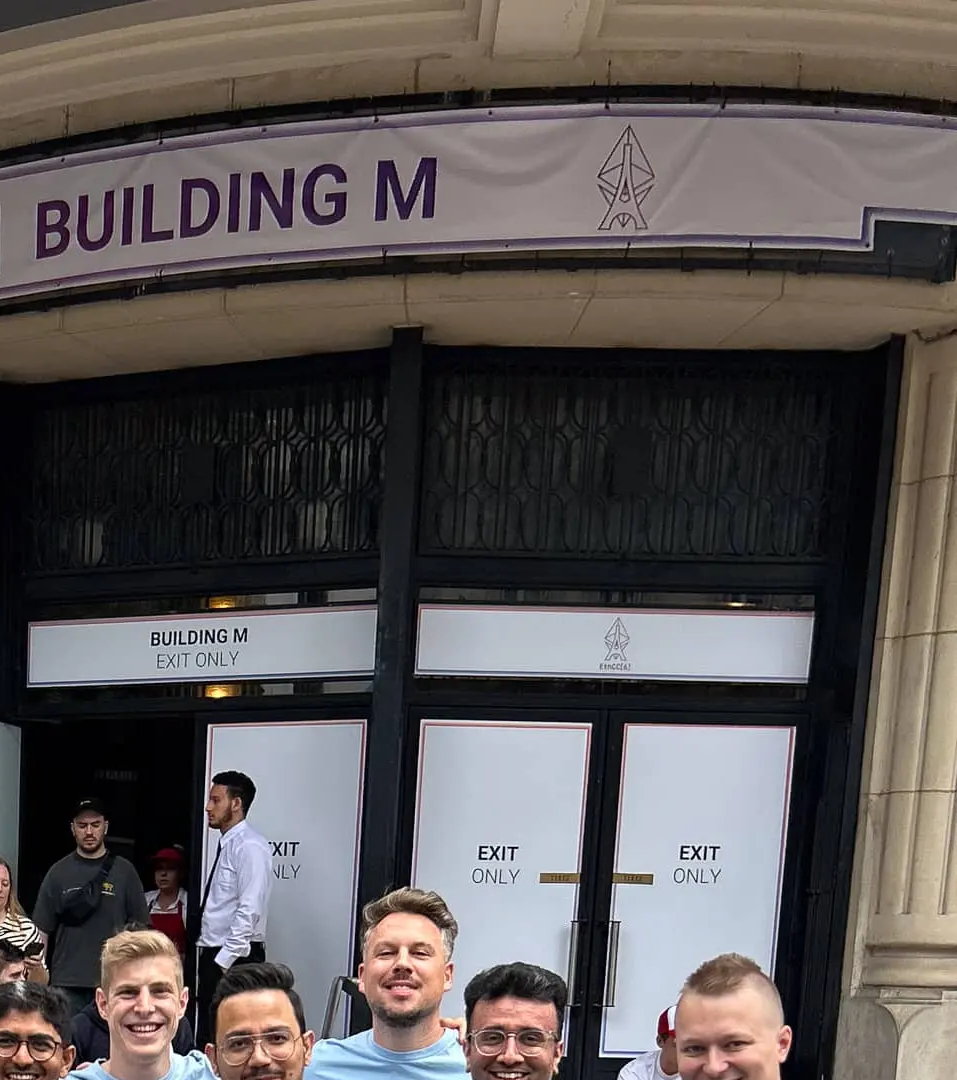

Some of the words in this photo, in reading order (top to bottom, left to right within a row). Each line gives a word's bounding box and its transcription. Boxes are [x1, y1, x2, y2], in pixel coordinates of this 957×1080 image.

[36, 163, 348, 260] BUILDING
[374, 156, 438, 222] M
[150, 629, 228, 647] BUILDING
[233, 628, 248, 643] M
[156, 653, 191, 669] EXIT
[195, 651, 239, 668] ONLY
[267, 841, 300, 857] XIT
[478, 845, 520, 861] EXIT
[680, 845, 721, 861] EXIT
[273, 864, 301, 880] NLY
[472, 868, 521, 885] ONLY
[673, 867, 722, 884] ONLY
